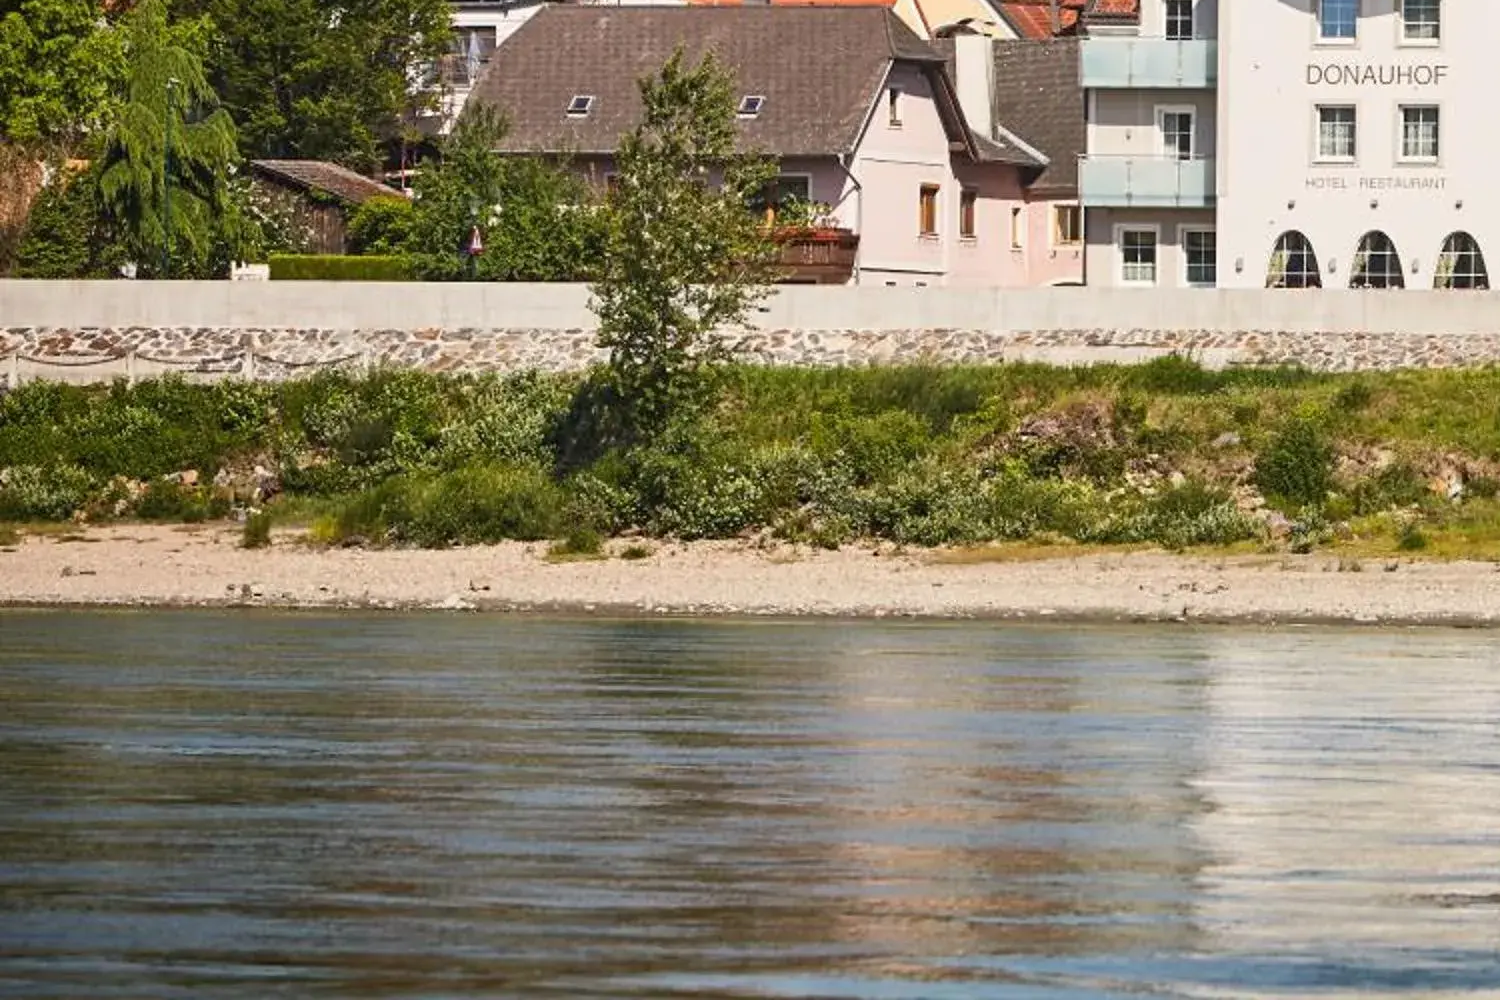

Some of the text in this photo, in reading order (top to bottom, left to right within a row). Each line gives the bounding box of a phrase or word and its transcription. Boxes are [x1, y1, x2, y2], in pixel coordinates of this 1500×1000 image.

[1306, 64, 1449, 85] DONAUHOF
[1305, 177, 1446, 189] HOTEL RESTAURANT
